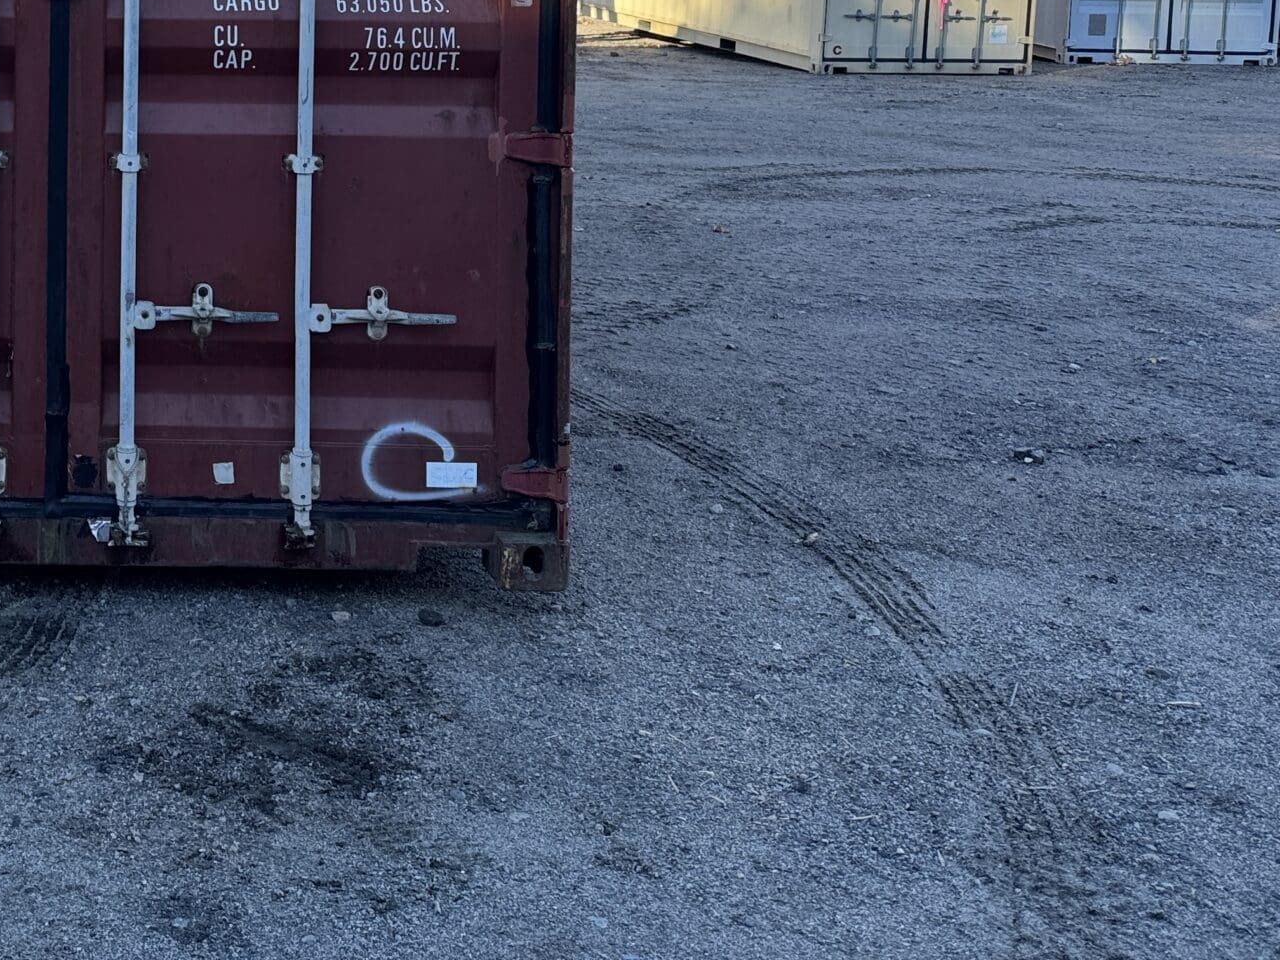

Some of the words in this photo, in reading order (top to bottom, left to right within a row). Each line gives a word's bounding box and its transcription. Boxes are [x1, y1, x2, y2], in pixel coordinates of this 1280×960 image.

[213, 24, 245, 47] CU.
[364, 27, 406, 49] 76.4
[411, 26, 461, 49] CU.M.
[213, 49, 256, 69] CAP.
[348, 51, 405, 71] 2.700
[409, 51, 461, 71] CU.FT.
[832, 45, 843, 56] C
